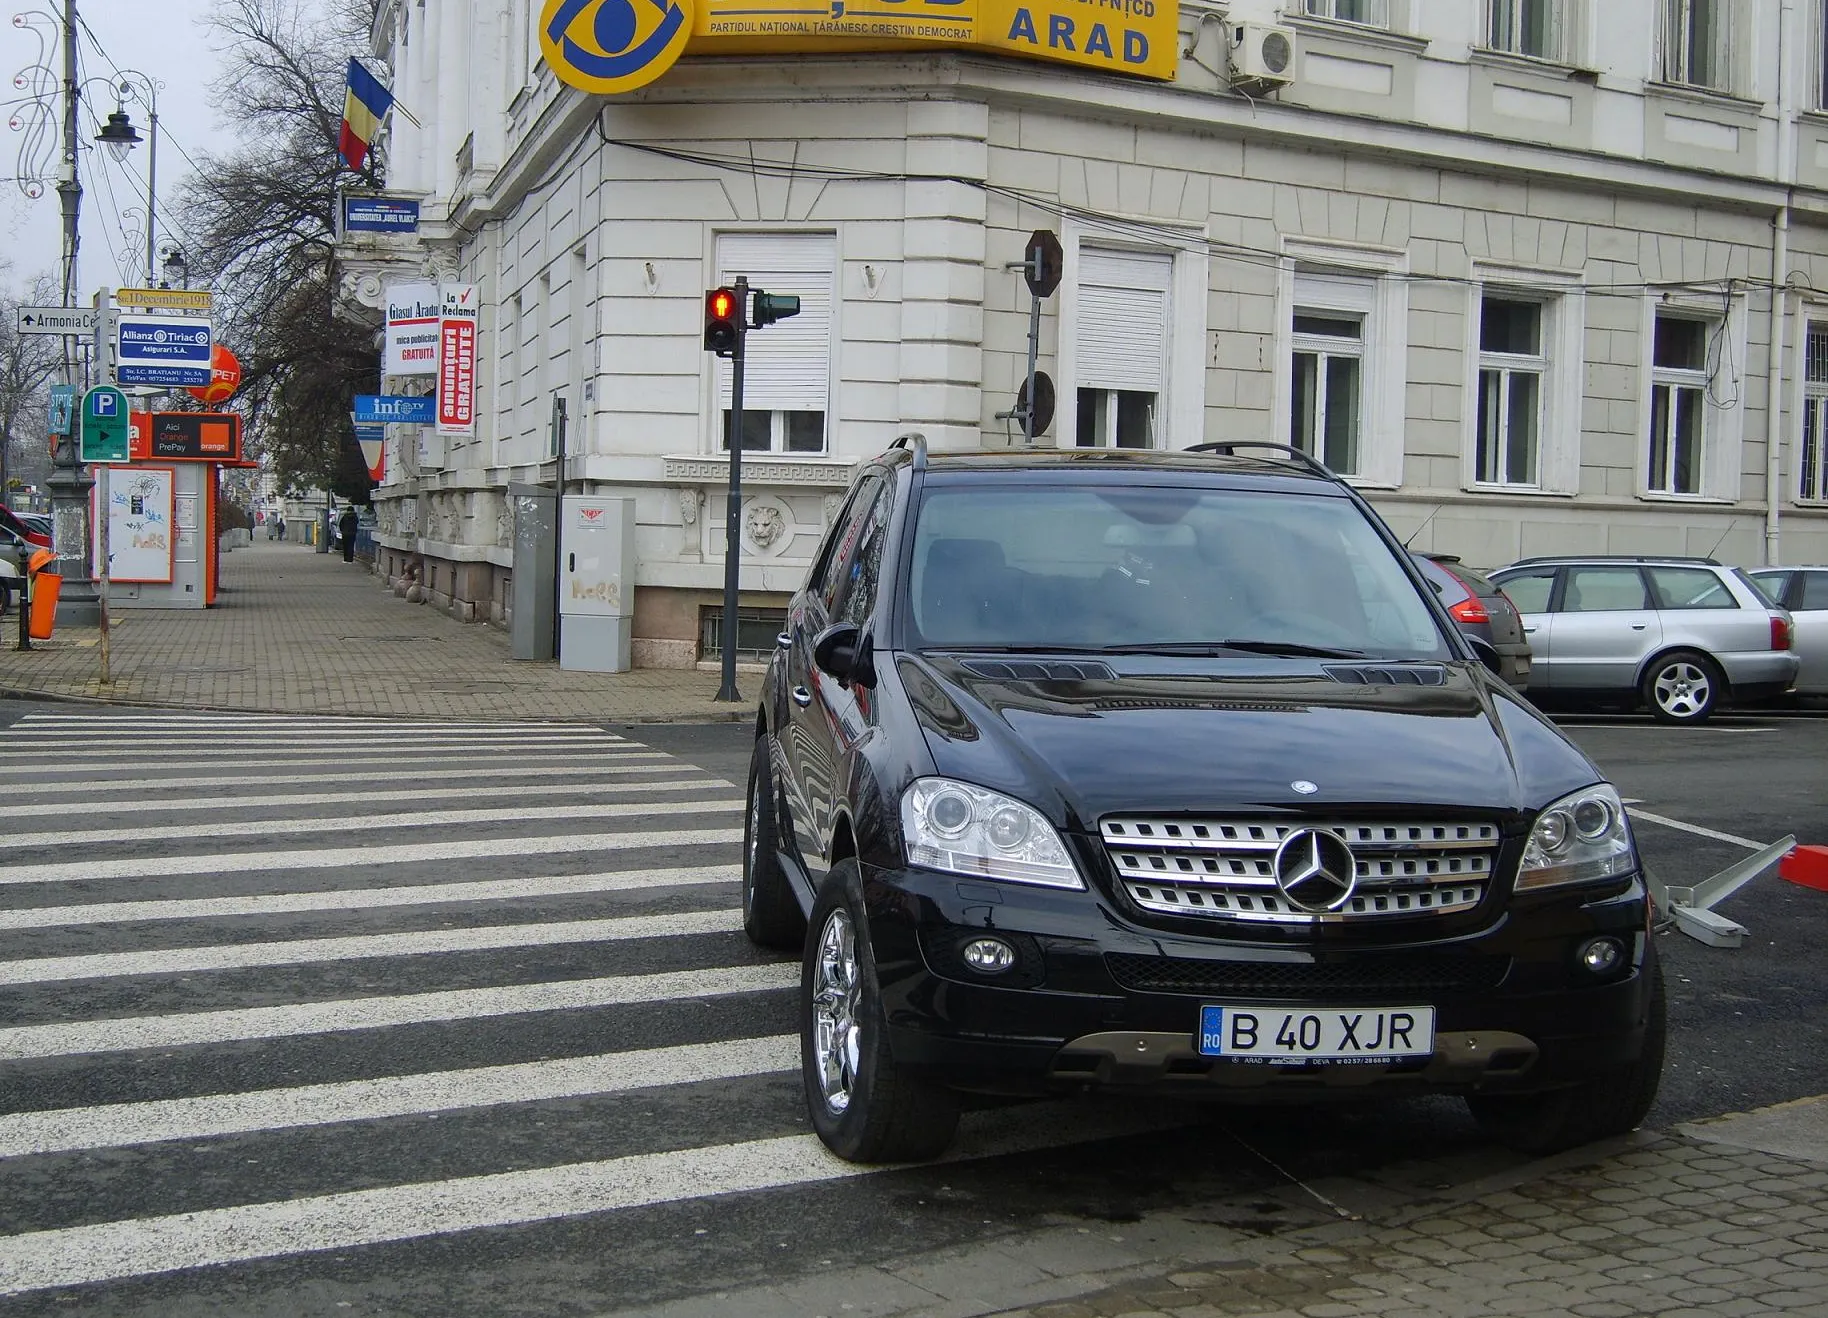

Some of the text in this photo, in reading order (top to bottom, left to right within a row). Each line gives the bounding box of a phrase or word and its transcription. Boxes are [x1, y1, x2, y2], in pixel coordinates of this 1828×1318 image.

[710, 22, 756, 33] PARTIDUL
[759, 22, 810, 35] NAȚIONAL
[871, 24, 915, 37] CREȘTIN
[918, 26, 972, 39] DEMOCRAT
[1007, 7, 1149, 64] ARAD
[135, 293, 189, 304] Decembrie
[447, 292, 456, 303] La
[389, 303, 413, 320] Glasul
[442, 305, 476, 316] Reclama
[37, 314, 81, 328] Armonia
[122, 331, 195, 342] Allianz Tiriac
[396, 335, 410, 345] mica
[142, 346, 172, 354] Asigurari
[457, 327, 472, 420] GRATUITE
[98, 394, 113, 414] P
[165, 423, 180, 431] Aici
[159, 443, 186, 452] PrePay
[1203, 1013, 1415, 1051] RO B 40 XJR
